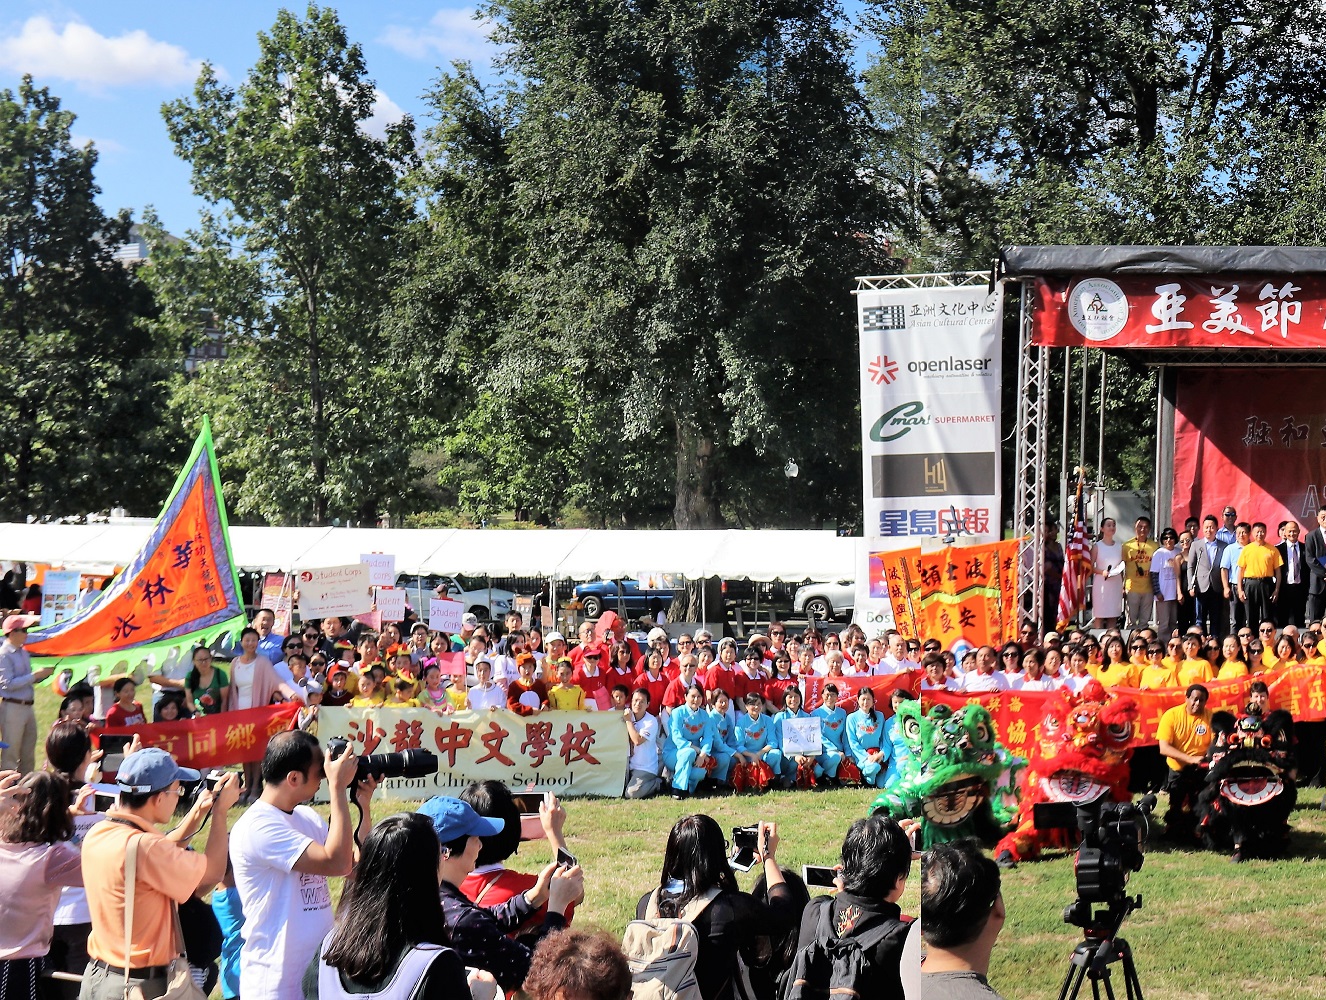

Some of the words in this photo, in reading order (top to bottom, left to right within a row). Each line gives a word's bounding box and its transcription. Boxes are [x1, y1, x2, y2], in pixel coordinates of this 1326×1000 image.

[908, 320, 931, 329] Asian
[933, 318, 966, 328] Cultural
[968, 317, 995, 326] Center
[907, 355, 991, 377] openlaser
[935, 415, 996, 423] SUPERMARKET
[314, 568, 344, 580] Student
[344, 567, 362, 578] Corps
[430, 606, 459, 619] Student
[511, 771, 574, 787] School
